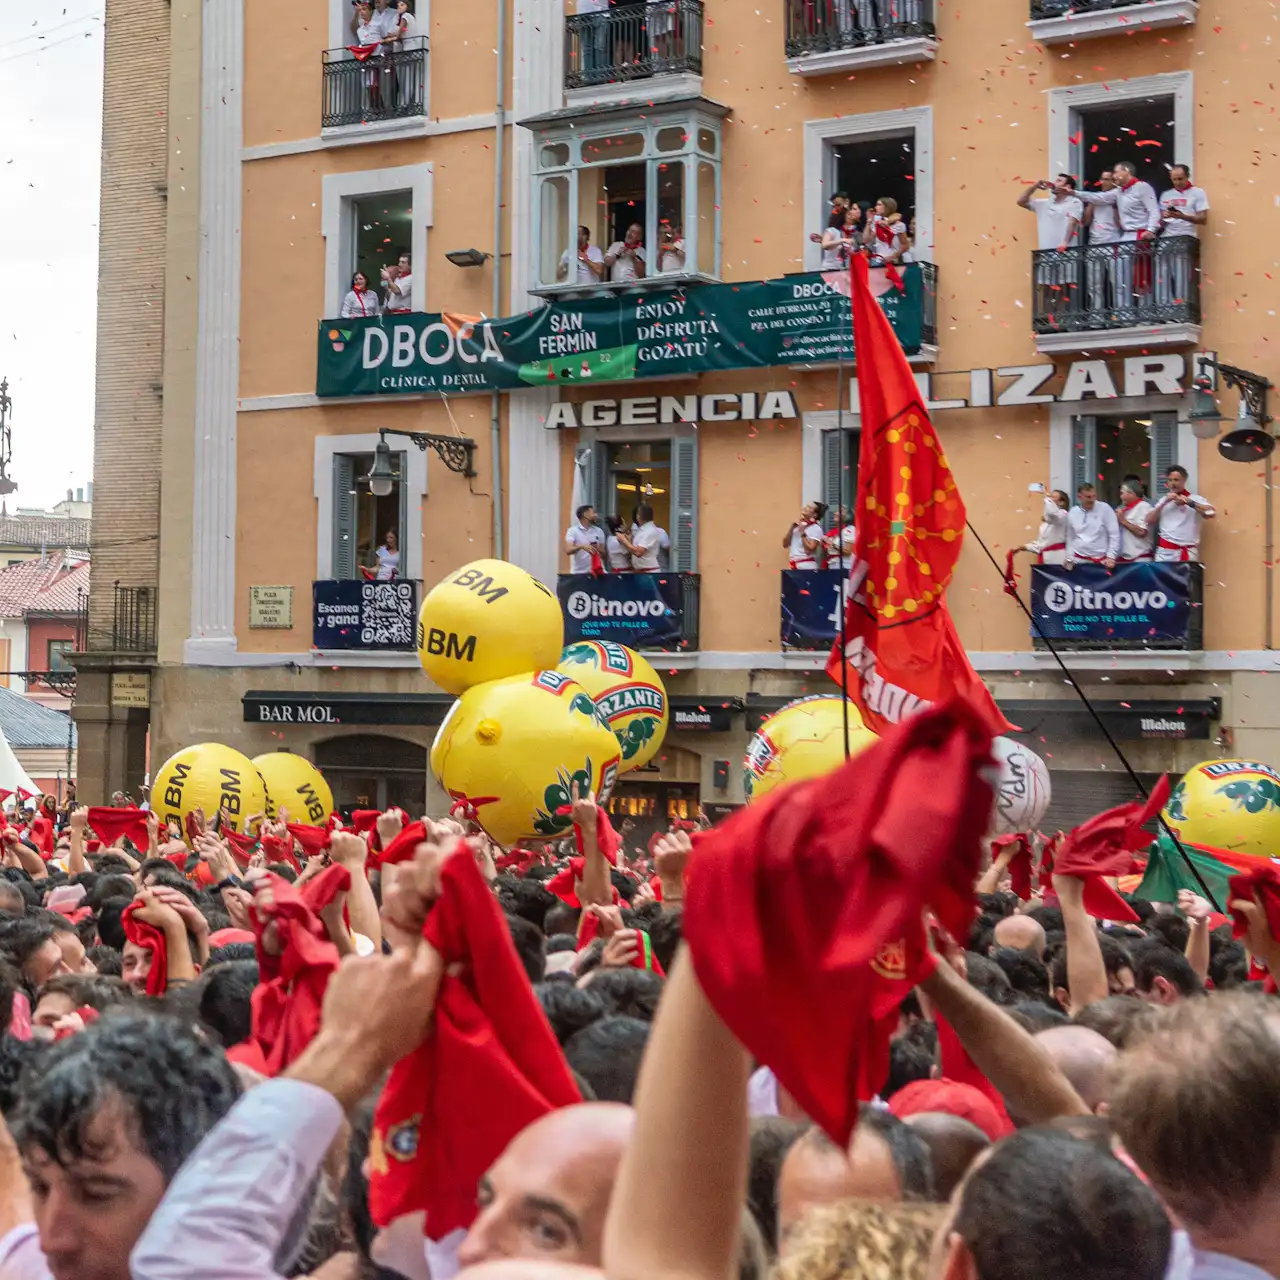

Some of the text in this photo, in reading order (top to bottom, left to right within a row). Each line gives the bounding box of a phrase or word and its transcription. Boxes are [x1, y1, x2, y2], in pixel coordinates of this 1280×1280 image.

[793, 282, 840, 298] DBOCA
[635, 300, 686, 320] ENJOY
[550, 312, 583, 333] SAN
[362, 323, 504, 369] DBOCA
[539, 329, 597, 354] FERMÍN
[381, 373, 487, 388] CLÍNICA DENTAL
[544, 351, 1219, 430] AGENCIA LIZARI
[453, 569, 509, 604] BM
[318, 603, 359, 613] Escanea
[318, 615, 325, 627] y
[327, 614, 359, 629] gana
[1064, 624, 1088, 632] TORO
[1086, 615, 1099, 623] NO
[1102, 615, 1112, 623] TE
[427, 628, 477, 662] BM
[259, 704, 335, 722] BAR MOL
[596, 690, 662, 718] RZANTE
[1141, 718, 1186, 731] Mahou
[164, 763, 192, 809] BM
[220, 768, 241, 815] BM
[296, 782, 325, 823] BM
